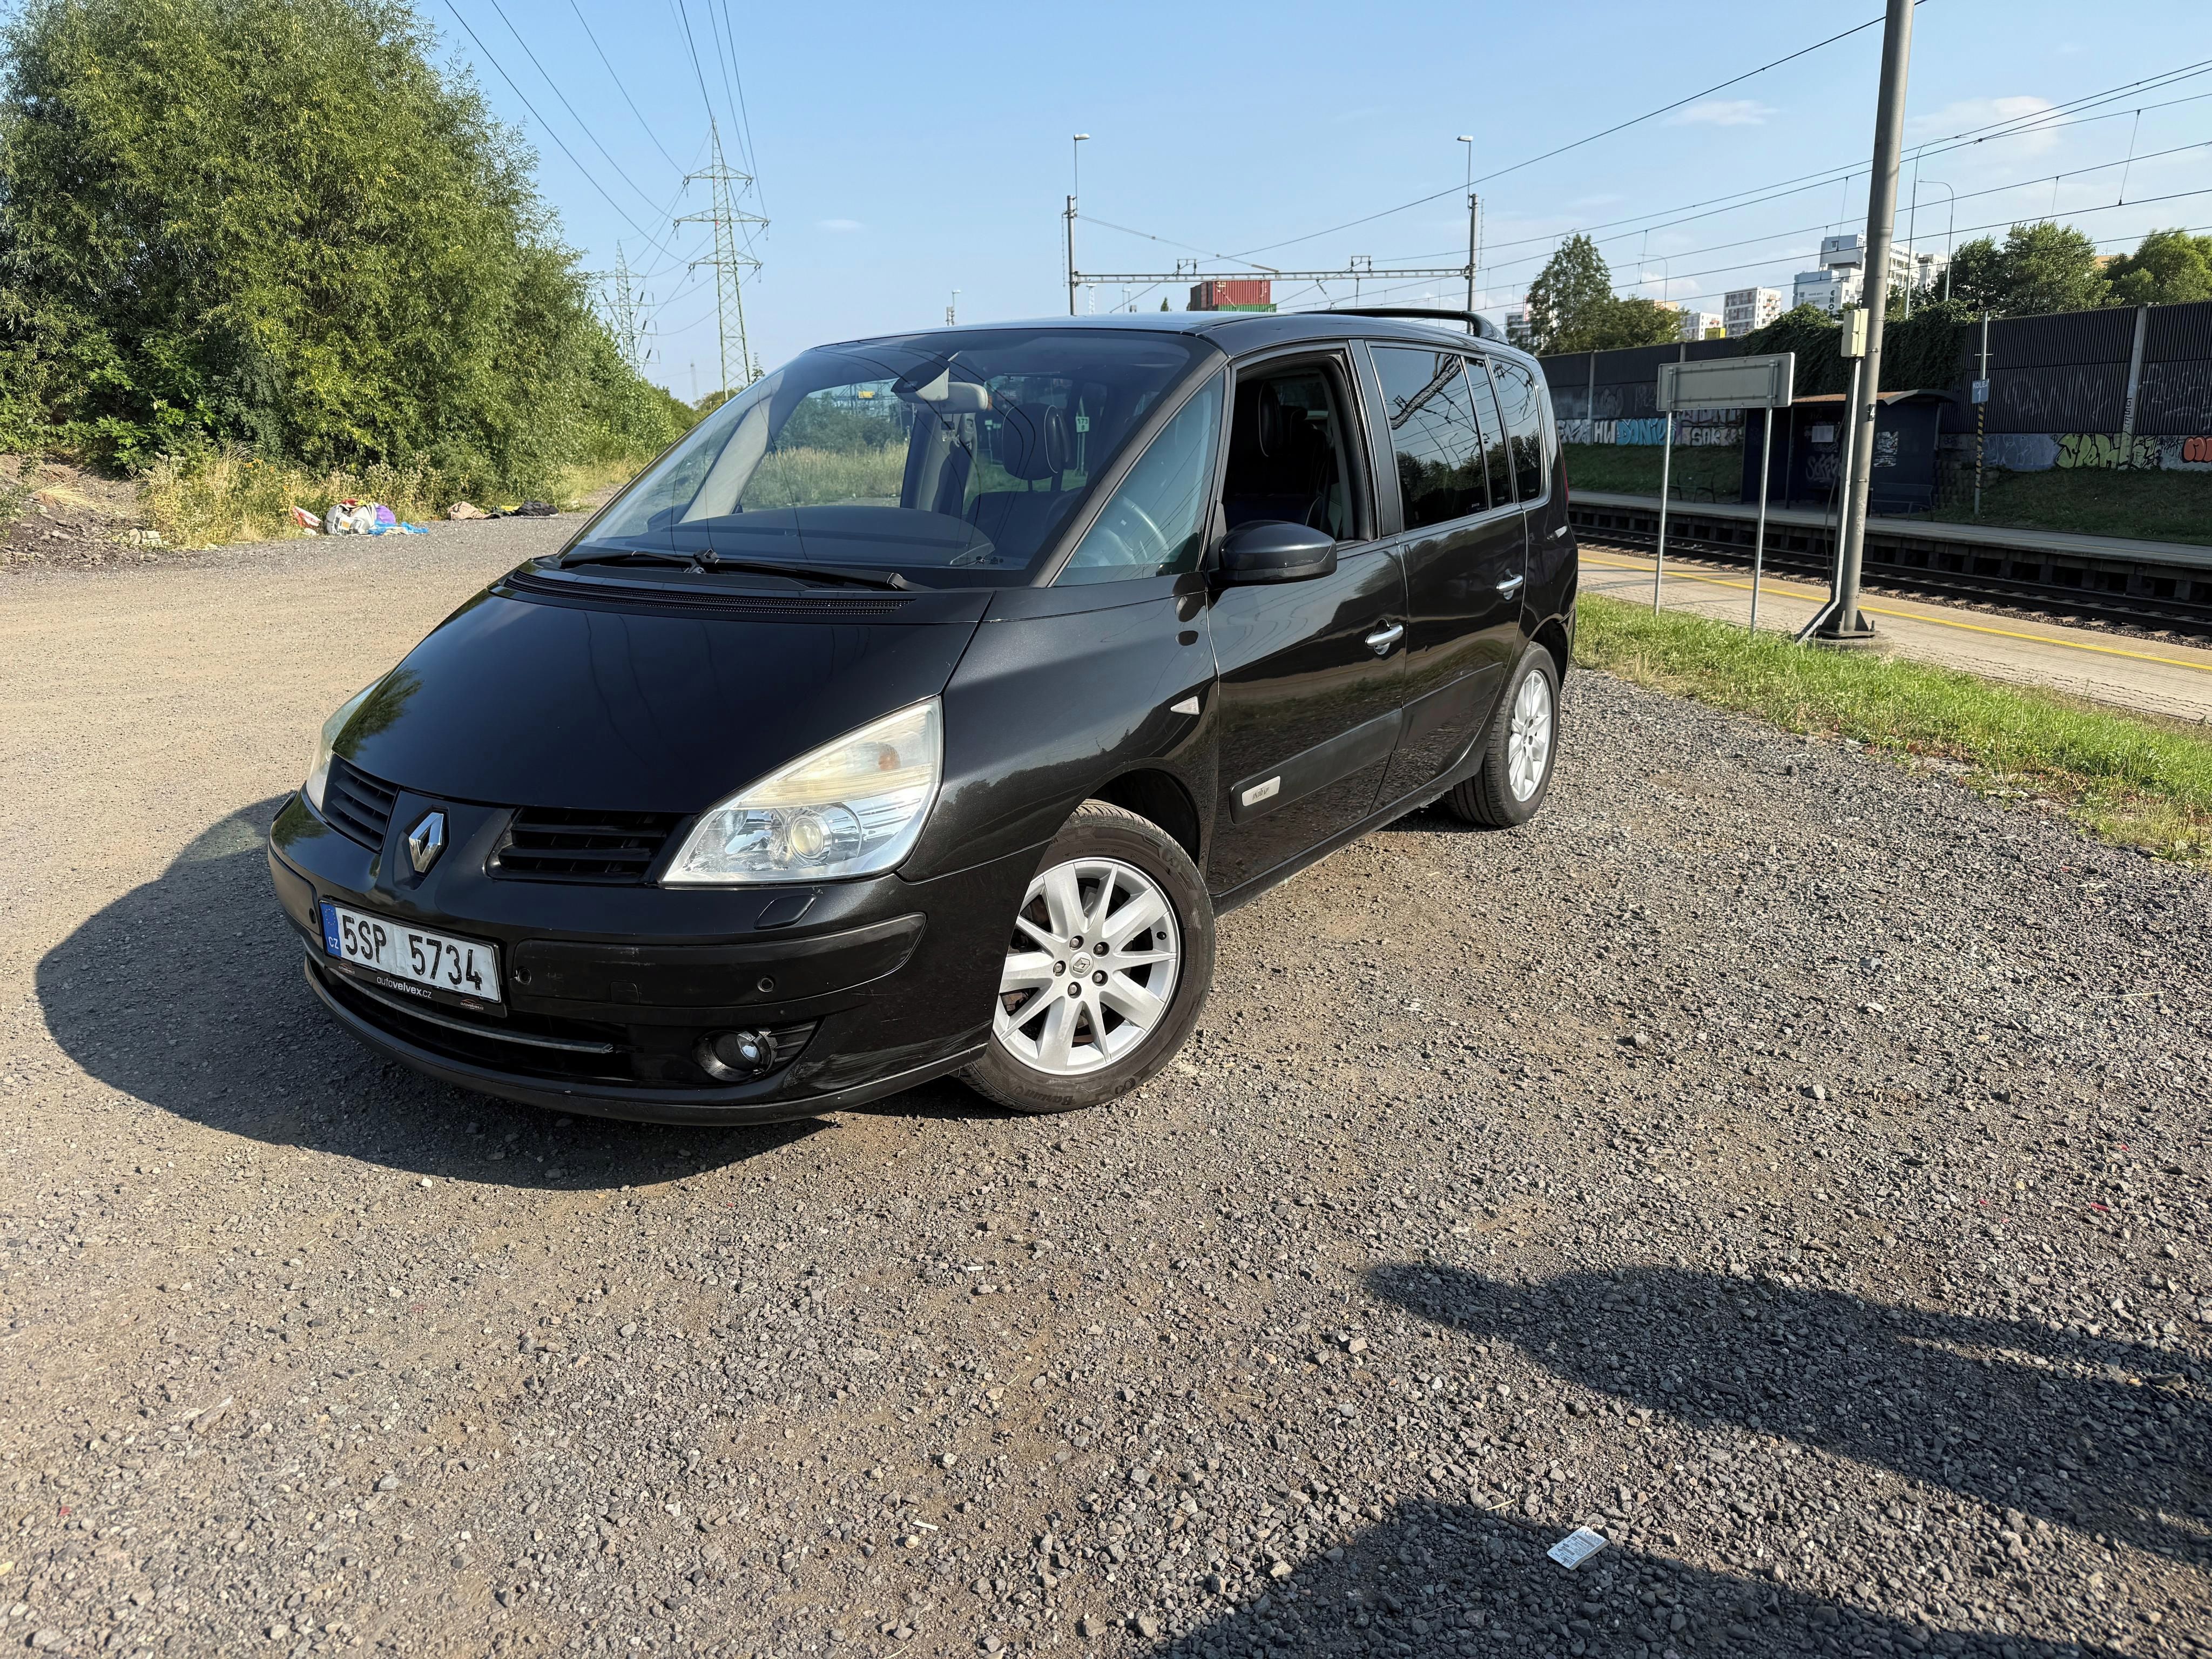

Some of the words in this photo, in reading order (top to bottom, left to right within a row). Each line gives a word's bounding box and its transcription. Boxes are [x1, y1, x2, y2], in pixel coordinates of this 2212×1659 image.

[1973, 380, 1988, 389] KOLEJ
[1978, 388, 1981, 401] 1
[1870, 407, 1875, 419] 4
[328, 936, 339, 950] CZ
[342, 915, 387, 964] 5SP
[408, 934, 483, 990] 5734
[376, 975, 432, 999] autovelvex.cz
[1023, 1089, 1076, 1105] Barum
